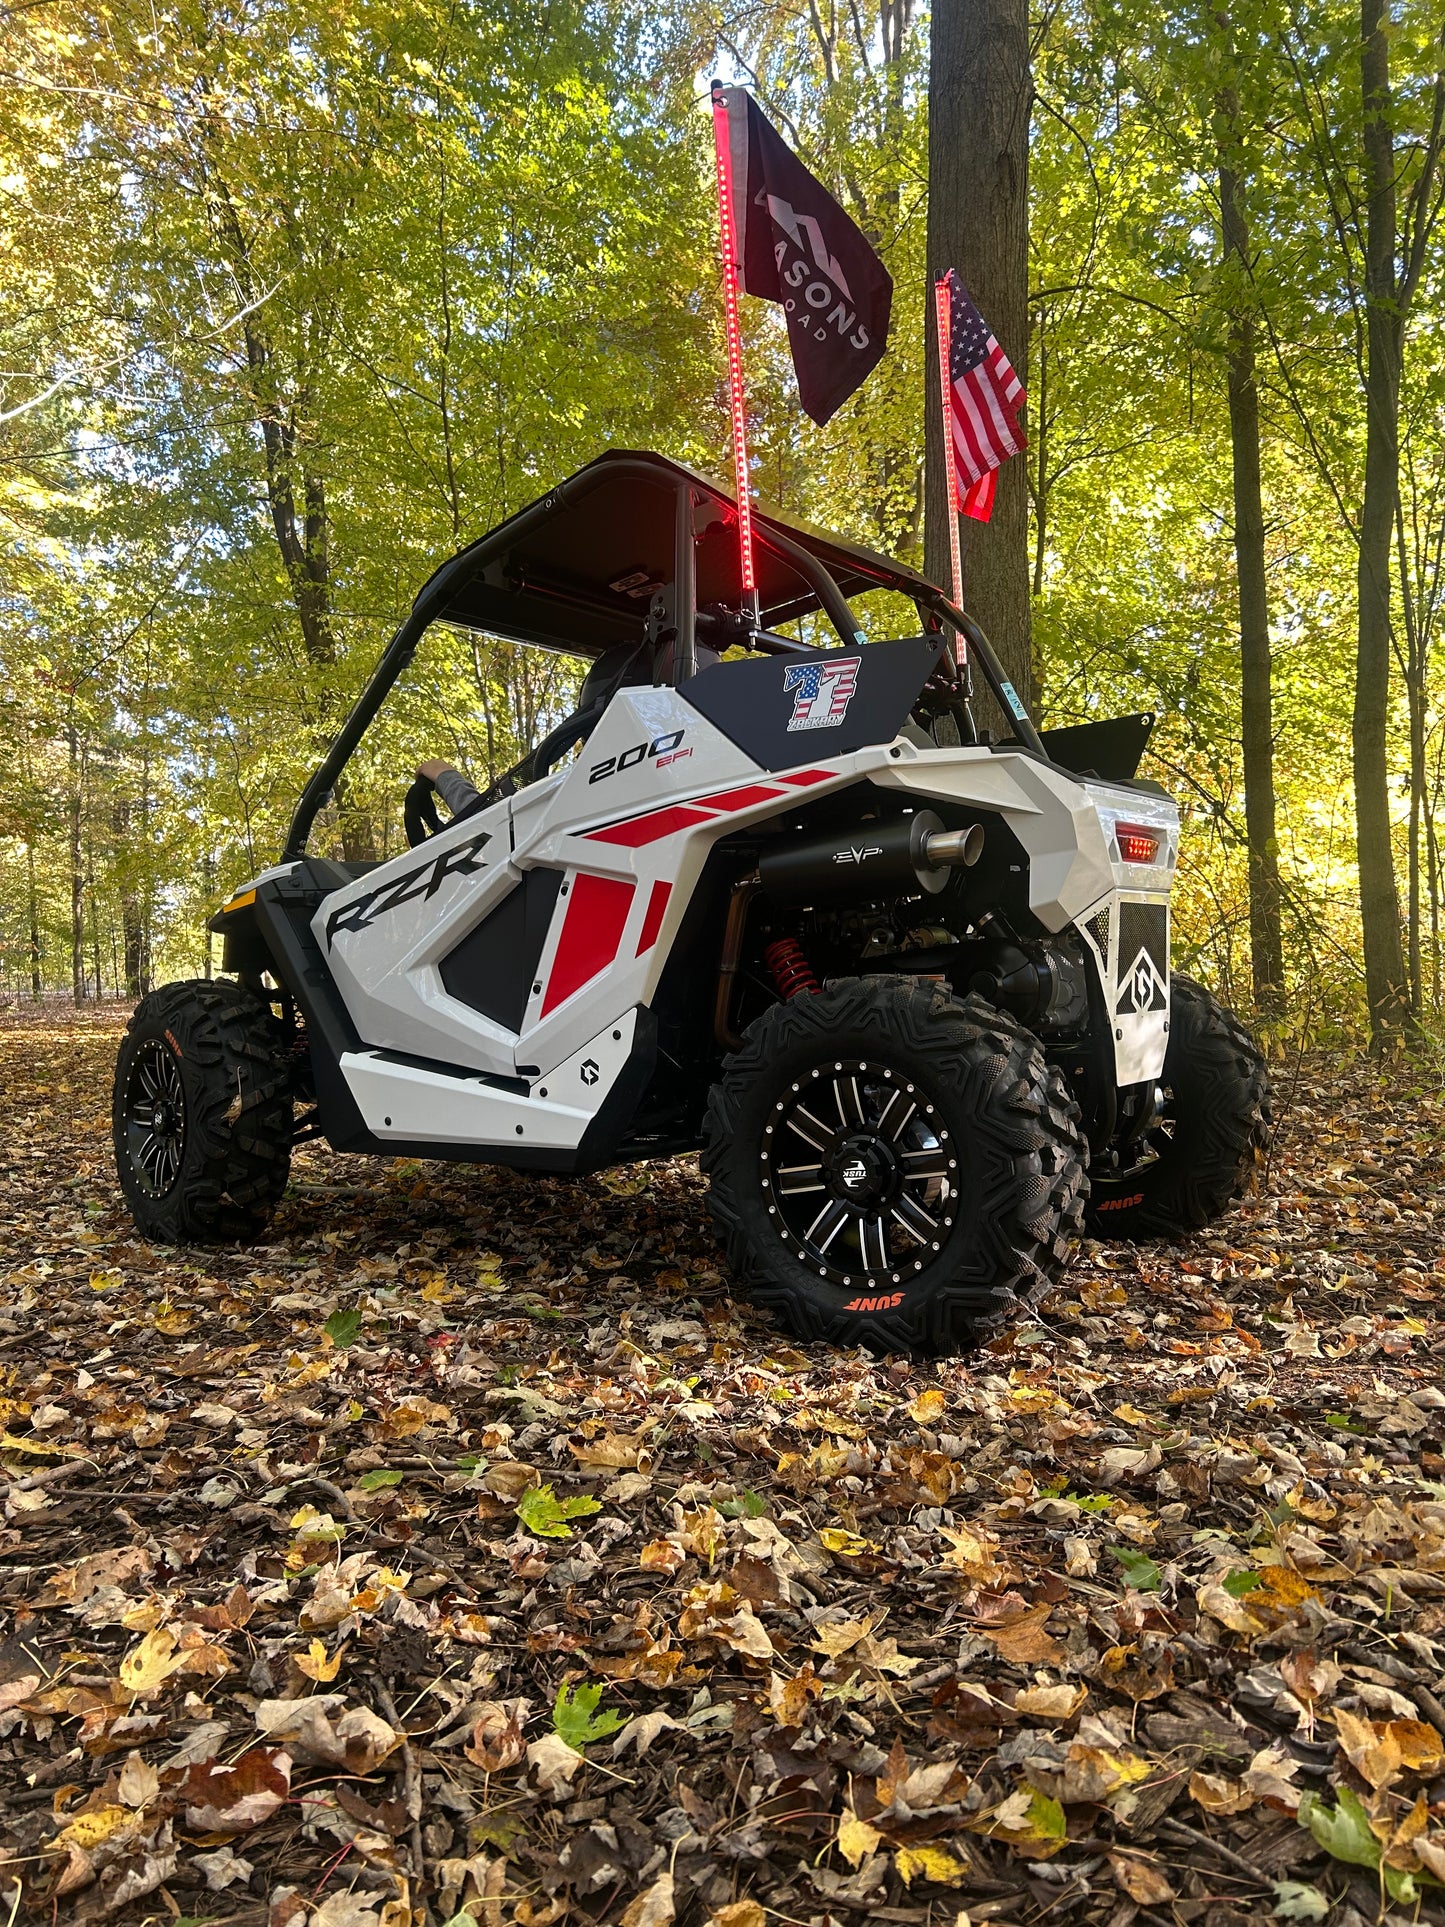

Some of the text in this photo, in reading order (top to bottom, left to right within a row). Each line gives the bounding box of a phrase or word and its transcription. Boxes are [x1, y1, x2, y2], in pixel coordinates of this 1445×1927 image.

[773, 238, 870, 350] ASONS
[783, 297, 827, 342] OAD
[788, 714, 845, 731] ZACKARY
[588, 728, 694, 785] 200 EFI
[835, 845, 880, 865] EVP
[325, 831, 493, 955] RZR
[842, 1170, 867, 1178] TUSK
[1096, 1193, 1145, 1211] SUNF
[842, 1292, 907, 1312] SUNF
